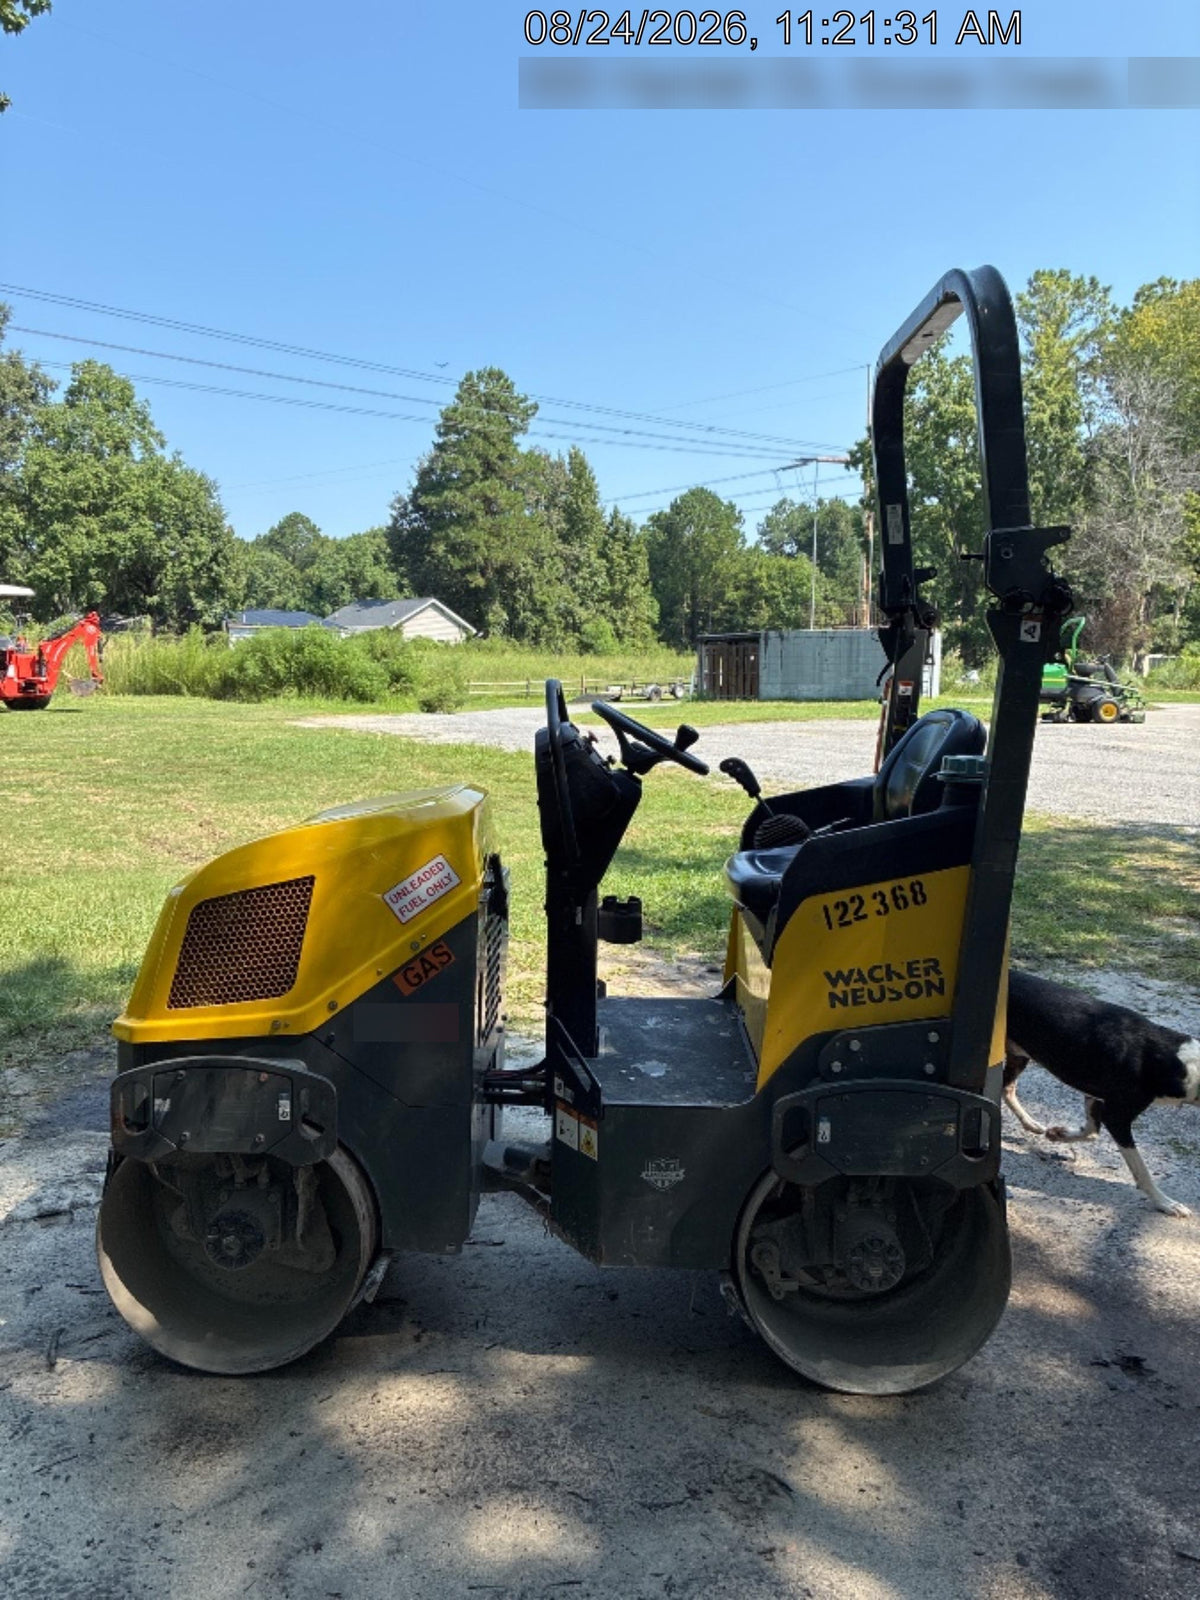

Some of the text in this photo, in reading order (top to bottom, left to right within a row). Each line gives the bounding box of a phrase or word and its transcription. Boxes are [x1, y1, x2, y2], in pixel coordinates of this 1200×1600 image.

[389, 861, 445, 905] UNLEADED
[398, 872, 454, 917] FUEL ONLY
[404, 944, 453, 987] GAS
[823, 958, 943, 989] WACKER
[828, 978, 946, 1009] NEUSON
